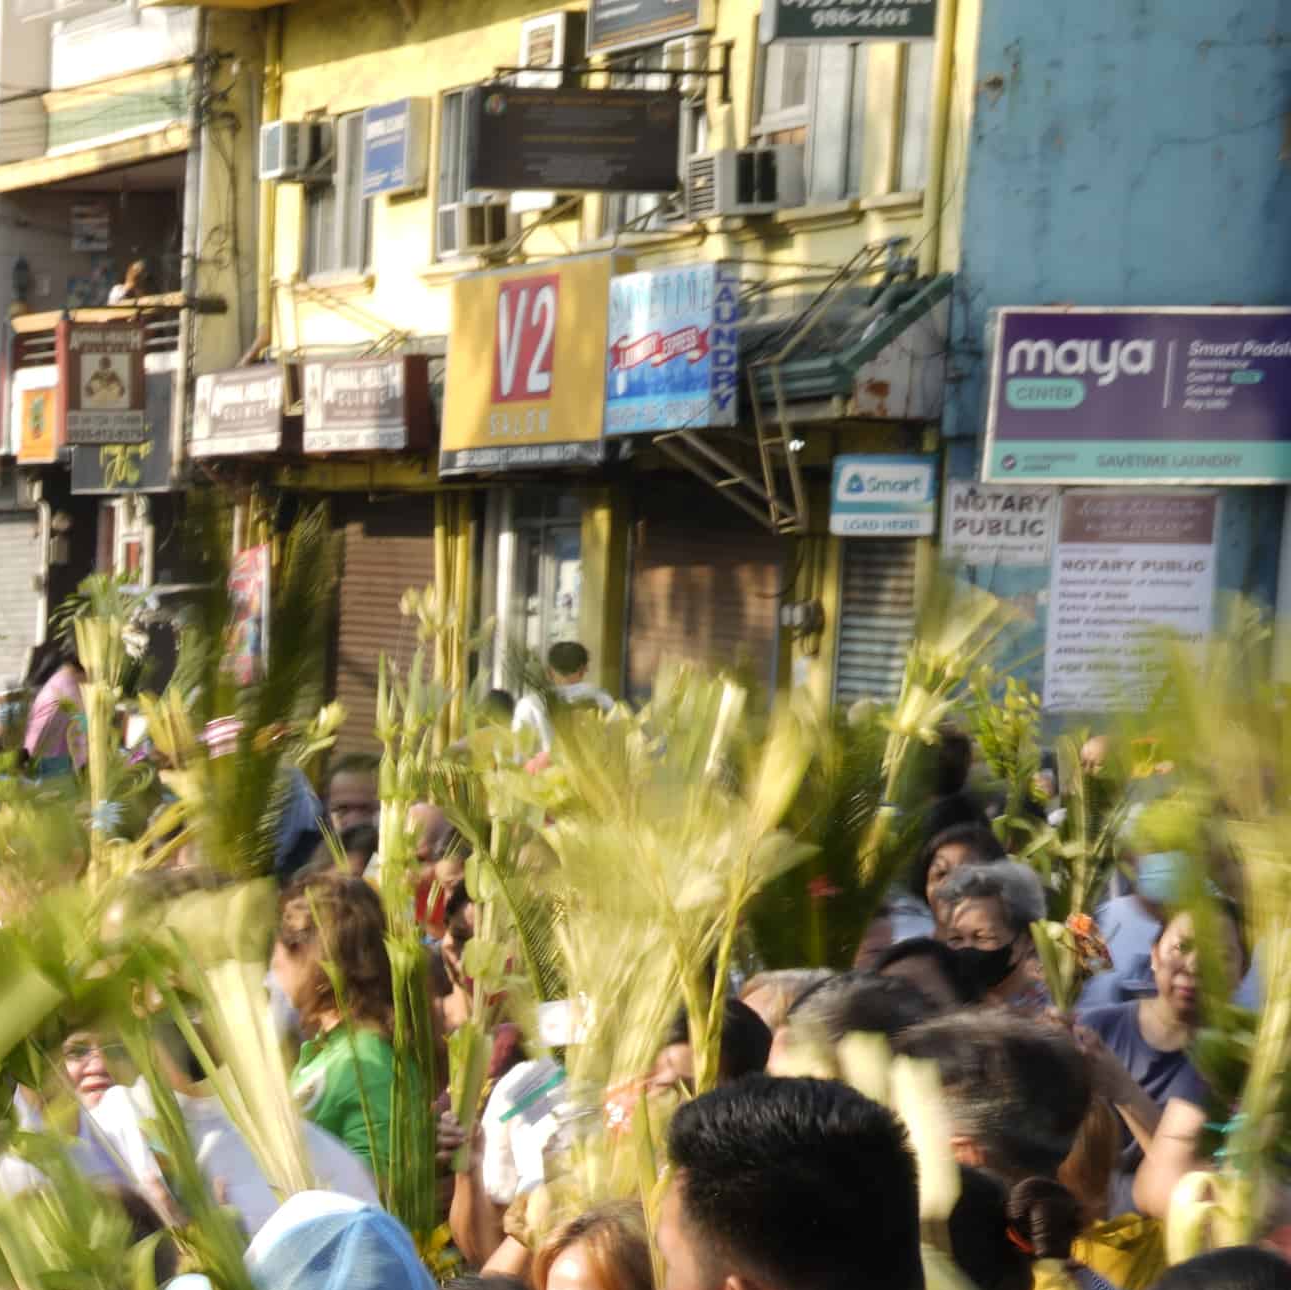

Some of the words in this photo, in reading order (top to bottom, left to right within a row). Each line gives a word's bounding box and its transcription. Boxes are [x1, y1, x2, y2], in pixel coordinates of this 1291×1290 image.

[810, 6, 910, 28] 986-2401
[498, 284, 557, 397] V2
[713, 270, 739, 412] LAUNDRY
[1187, 340, 1241, 357] Smart
[1006, 338, 1156, 386] maya
[1015, 386, 1073, 400] CENTER
[490, 407, 551, 437] SALON
[1097, 455, 1166, 468] SAVETIME
[1171, 455, 1242, 468] LAUNDRY
[867, 475, 922, 494] Smart
[953, 494, 1050, 513] NOTARY
[843, 519, 878, 530] LOAD
[952, 518, 1045, 537] PUBLIC
[1060, 559, 1135, 573] NOTARY
[1141, 559, 1206, 573] PUBLIC
